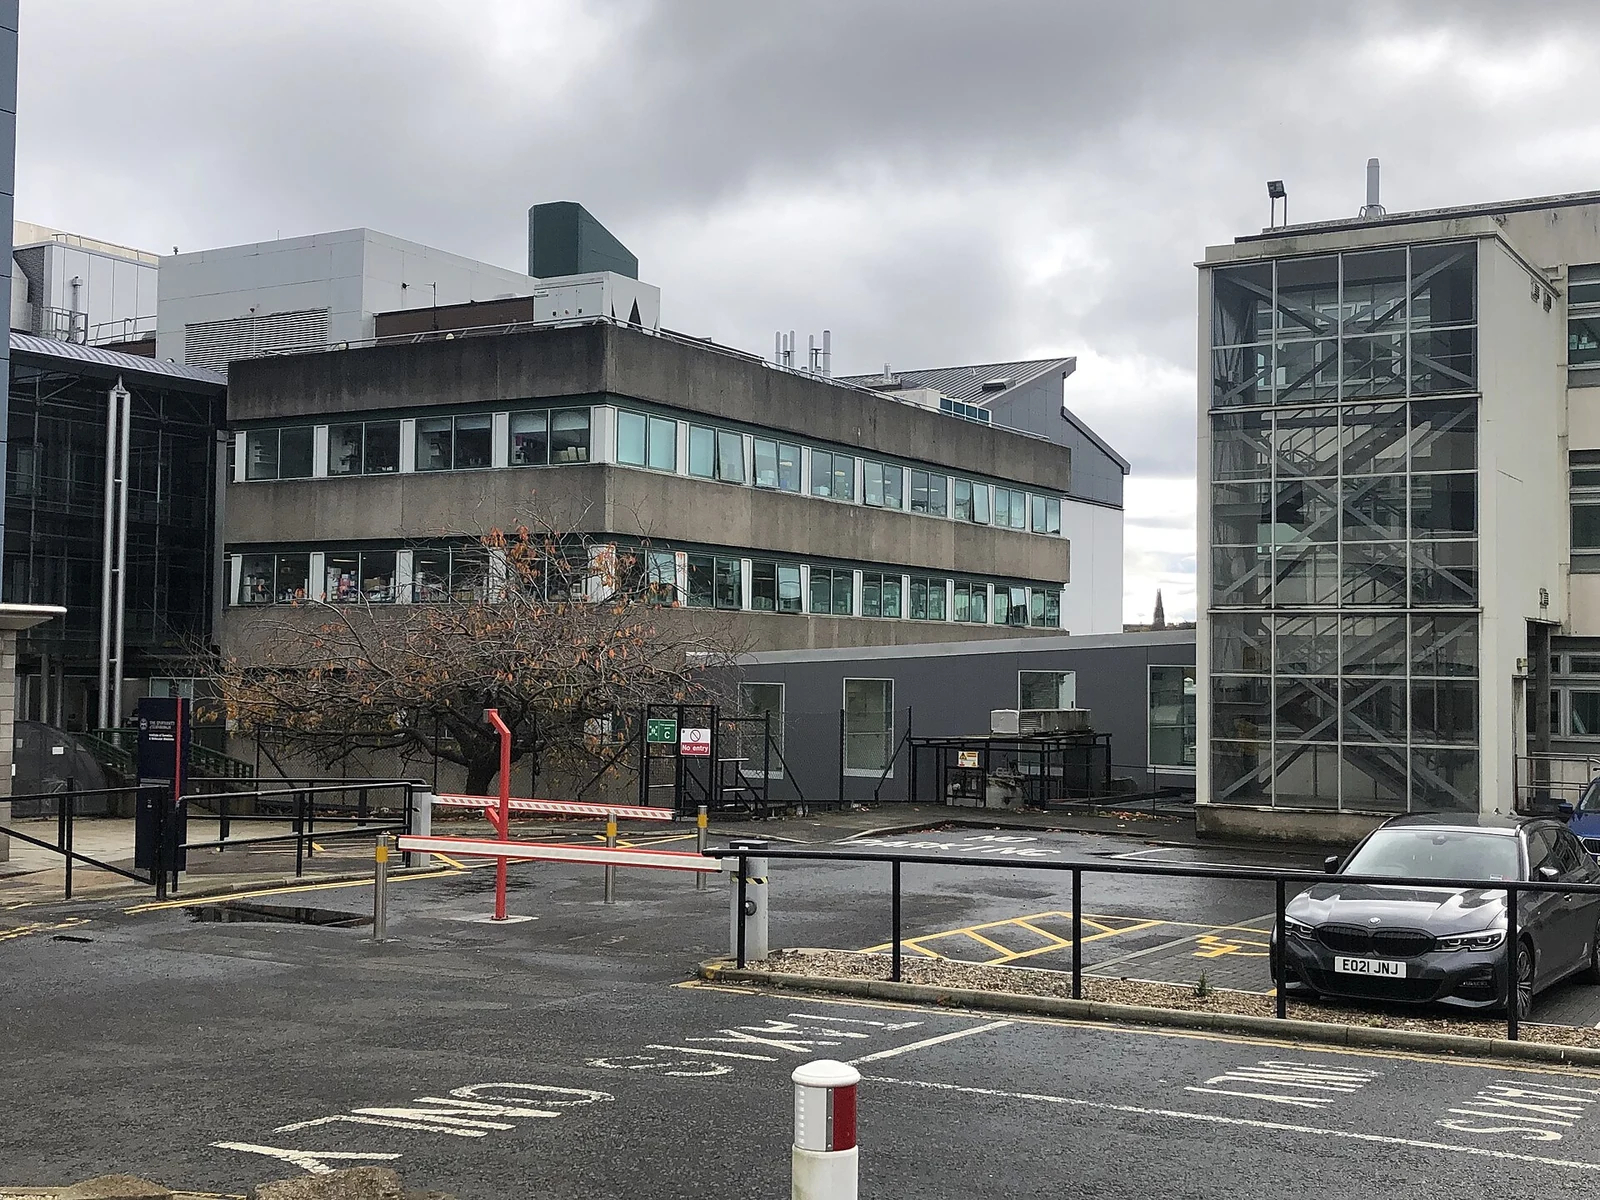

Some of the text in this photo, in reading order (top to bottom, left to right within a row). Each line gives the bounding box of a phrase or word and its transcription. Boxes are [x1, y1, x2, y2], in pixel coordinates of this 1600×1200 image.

[664, 731, 671, 739] C
[692, 745, 709, 753] entry
[964, 835, 1038, 843] NO
[834, 839, 1062, 857] PARKING
[1374, 961, 1399, 975] JNJ
[208, 1081, 616, 1175] ONLY
